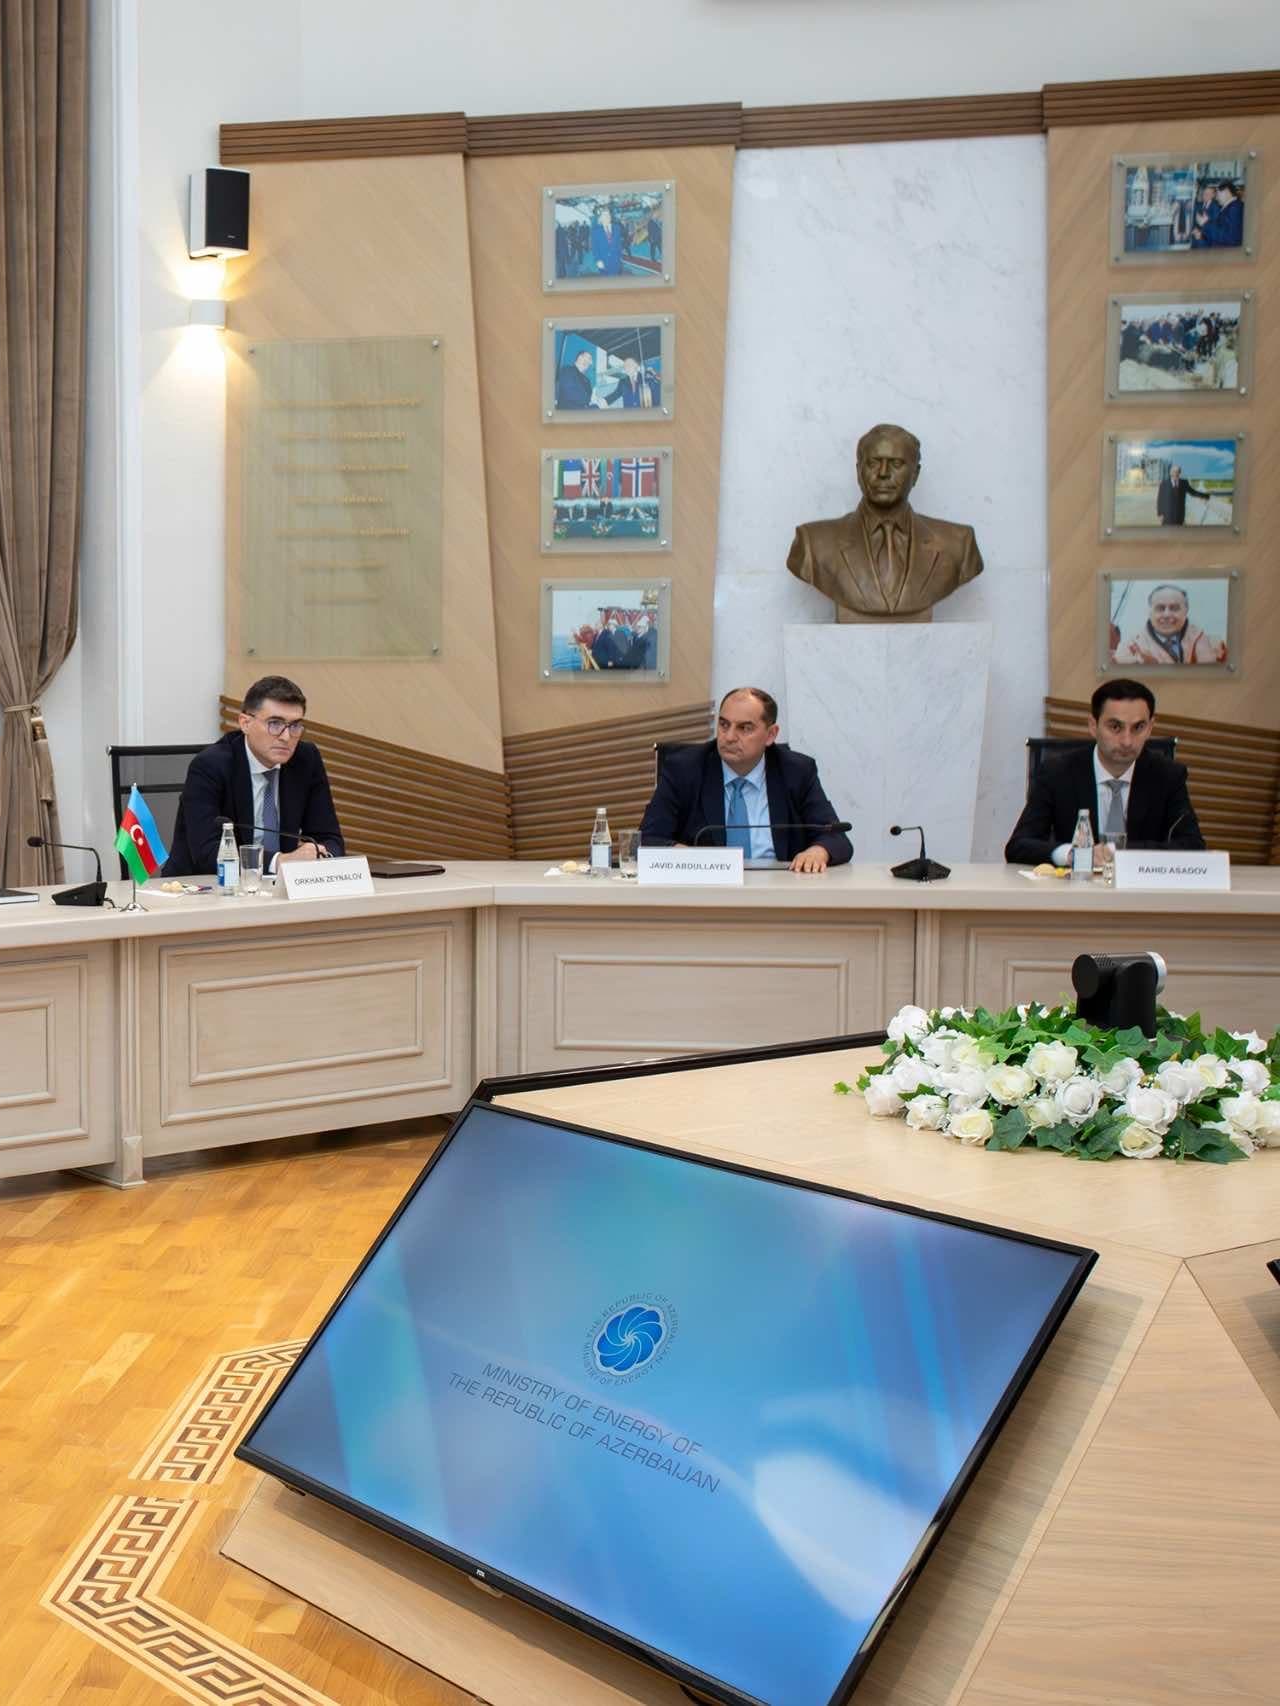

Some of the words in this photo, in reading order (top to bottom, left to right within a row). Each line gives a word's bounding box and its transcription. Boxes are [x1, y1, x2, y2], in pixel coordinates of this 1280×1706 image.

[649, 862, 674, 870] JAVID
[675, 863, 732, 871] ABDULLAYEV
[1168, 866, 1208, 875] ASADOV
[294, 876, 325, 886] ORKHAN
[326, 872, 362, 883] ZEYNALOV
[481, 1363, 565, 1402] MINISTRY
[564, 1394, 593, 1413] OF
[592, 1405, 672, 1445] ENERGY
[672, 1436, 703, 1456] OF
[448, 1372, 482, 1396] THE
[481, 1386, 567, 1430] REPUBLIC
[568, 1421, 597, 1440] OF
[595, 1433, 721, 1493] AZERBAIJAN
